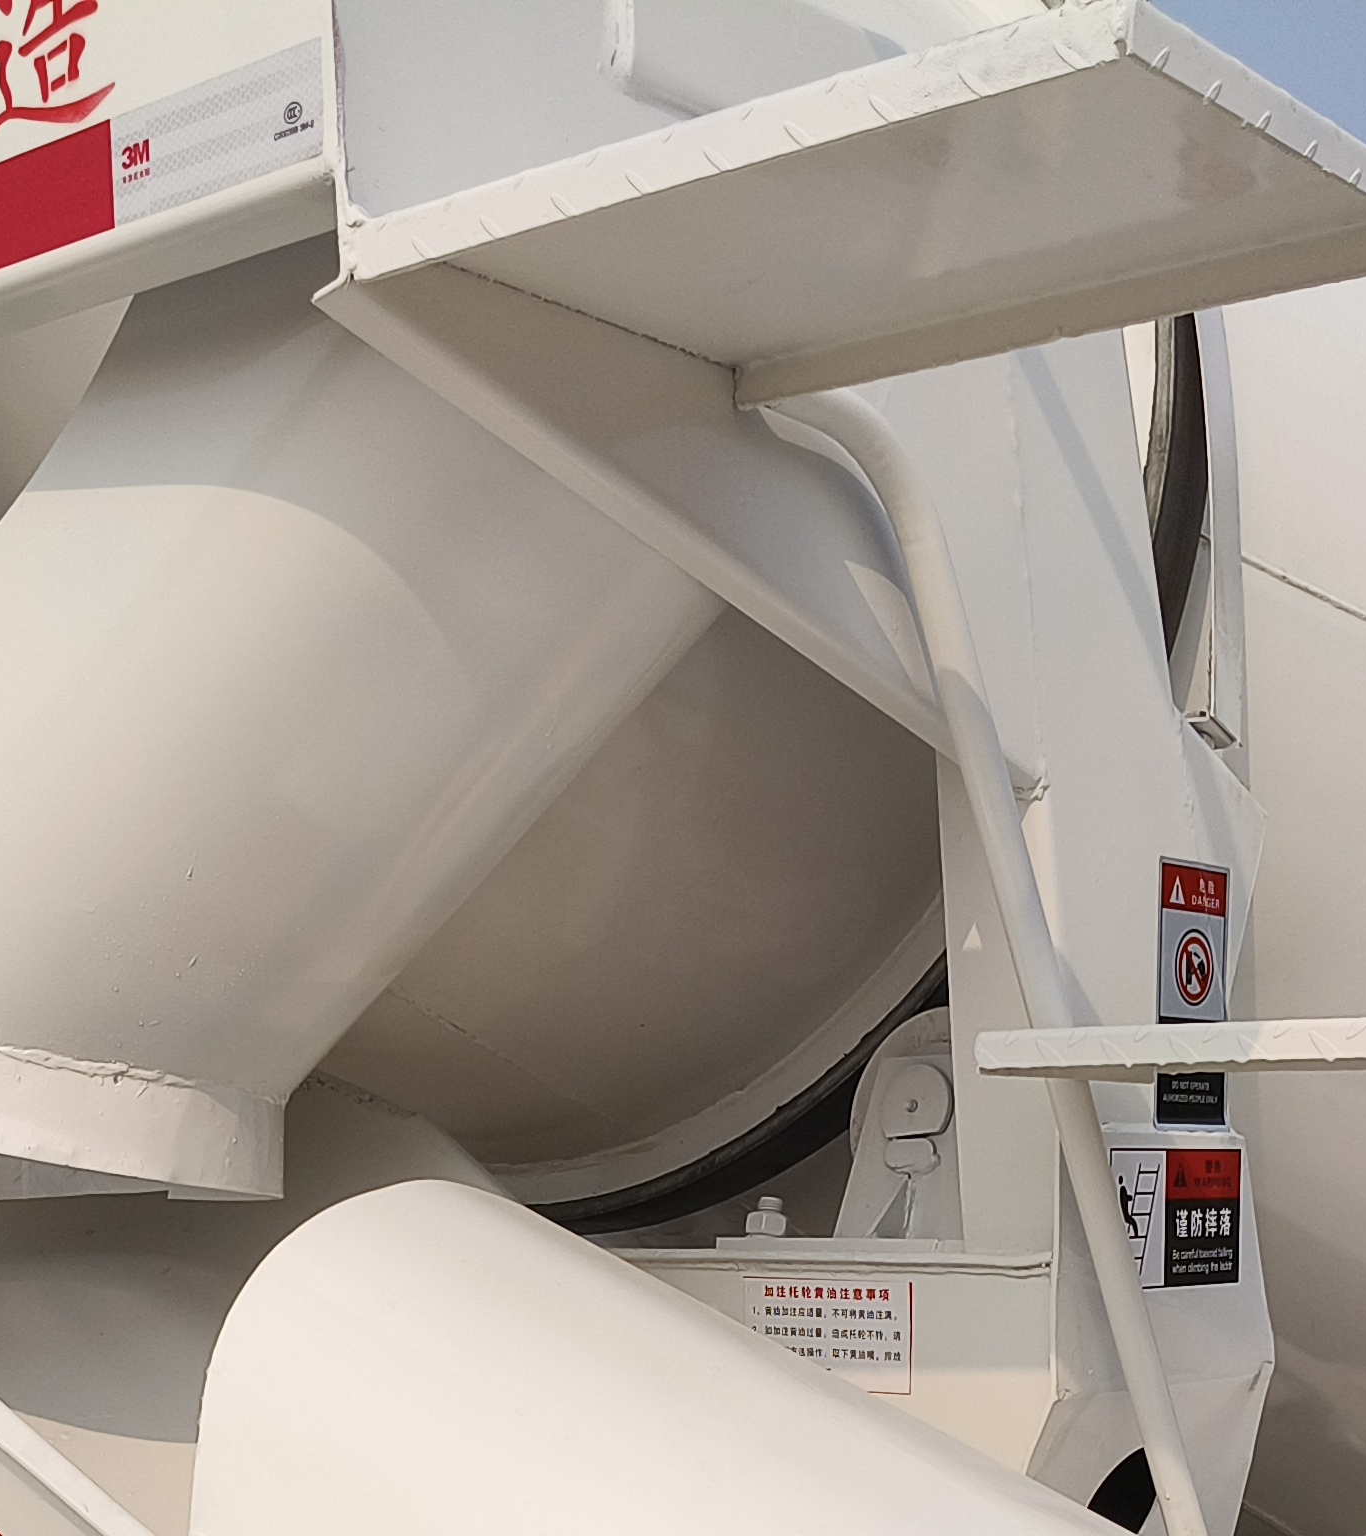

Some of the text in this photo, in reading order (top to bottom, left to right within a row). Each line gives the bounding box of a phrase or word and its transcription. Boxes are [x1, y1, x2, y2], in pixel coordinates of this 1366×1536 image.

[121, 139, 150, 170] 3M
[1191, 894, 1220, 909] DANGER
[764, 1285, 890, 1301] 加注托轮黄油注意事项
